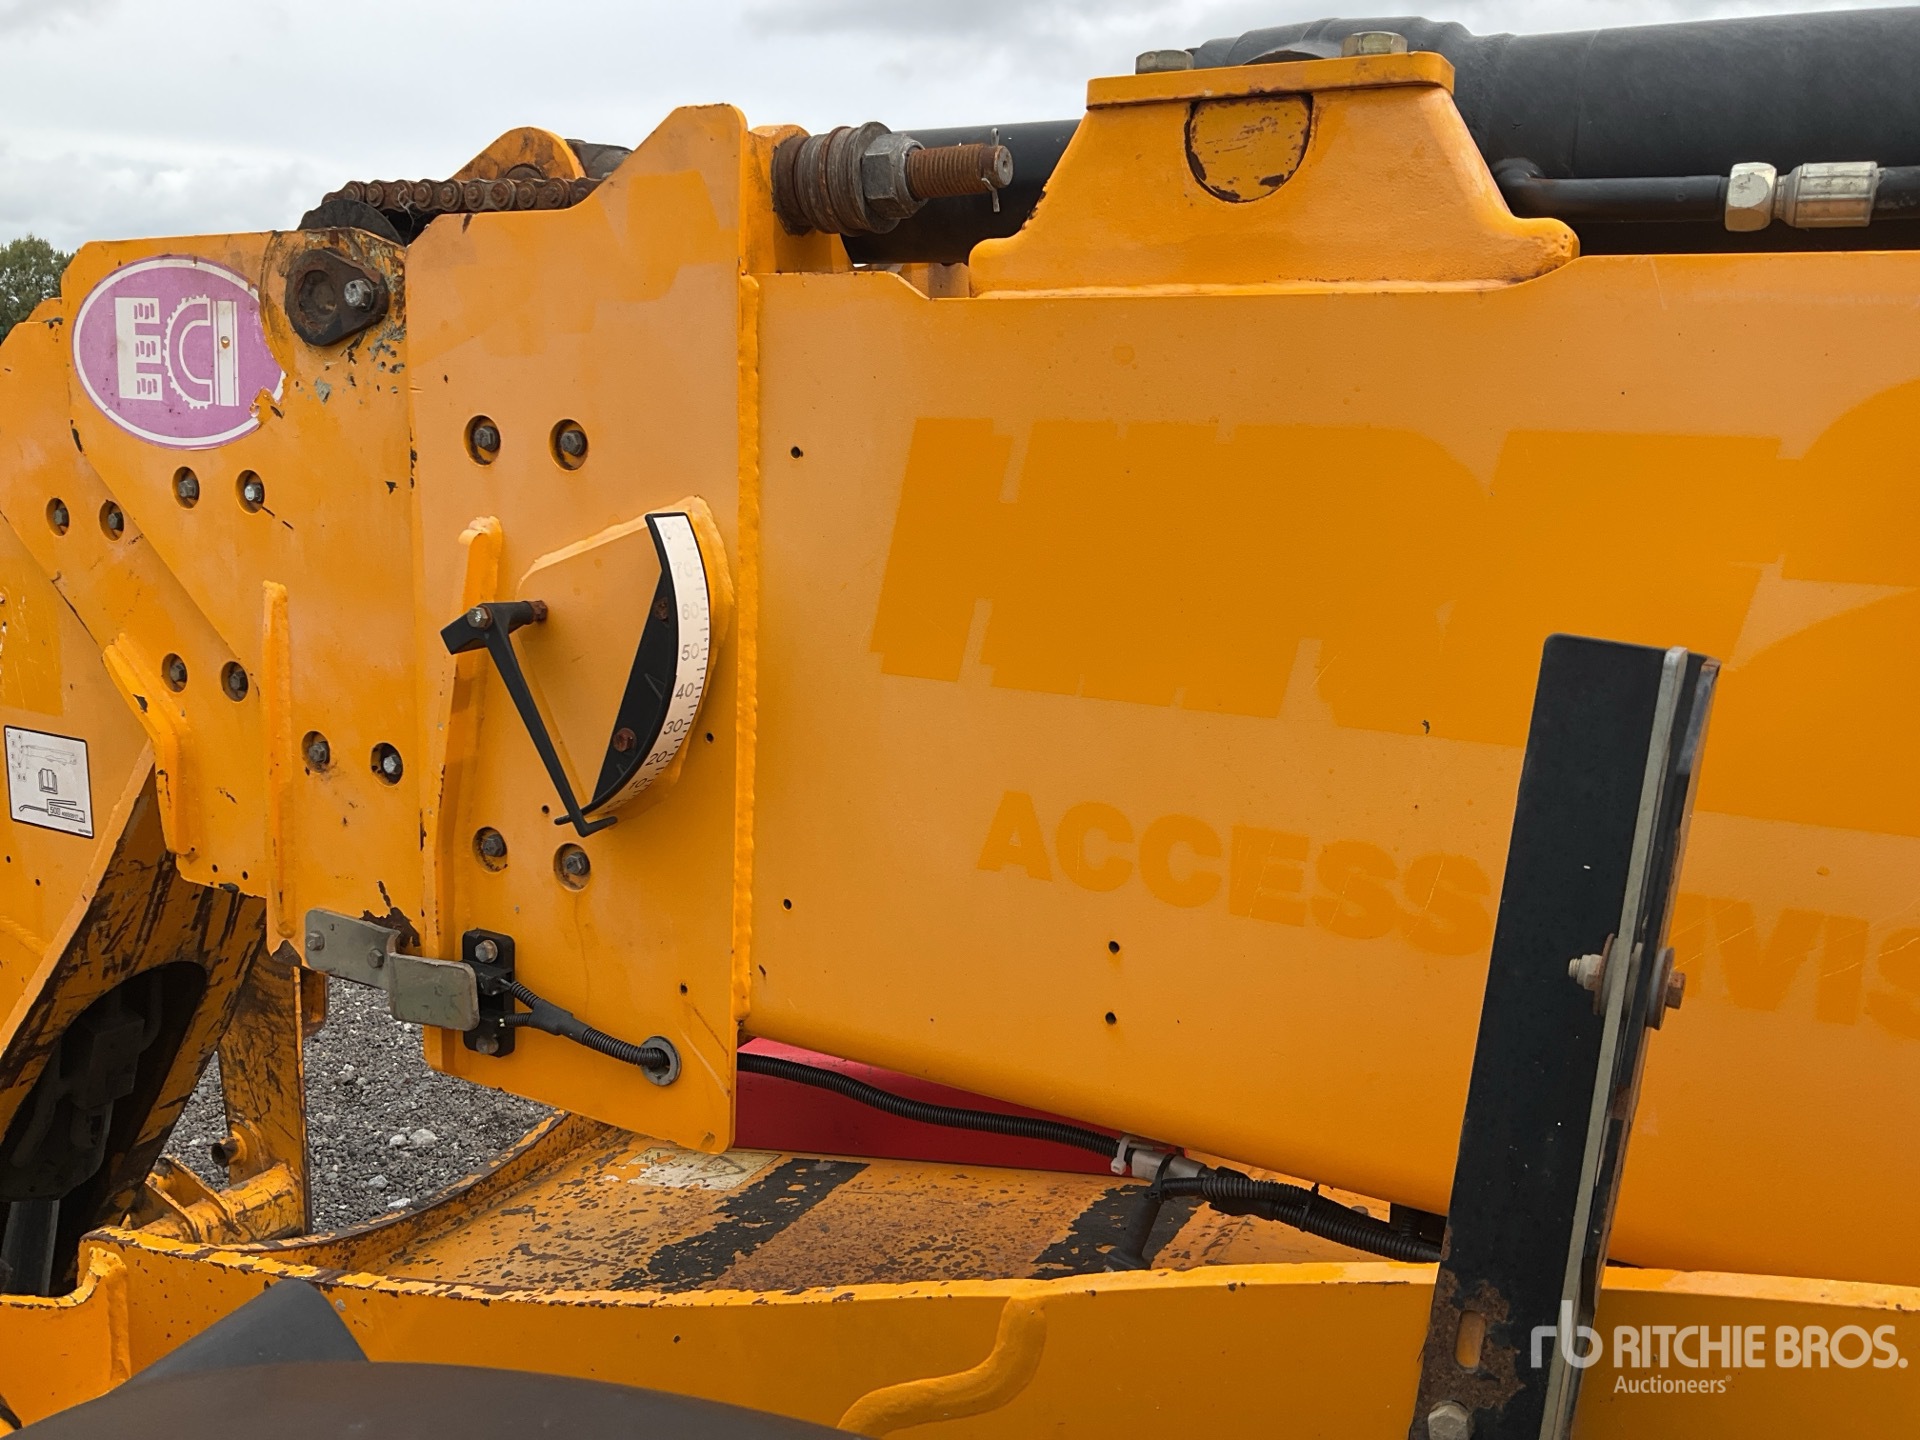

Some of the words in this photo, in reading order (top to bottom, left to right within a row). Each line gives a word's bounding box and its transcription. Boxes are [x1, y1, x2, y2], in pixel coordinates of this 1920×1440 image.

[673, 561, 693, 579] 70
[681, 602, 700, 620] 60
[681, 643, 700, 661] 50
[675, 682, 695, 699] 40
[663, 719, 684, 735] 30
[645, 750, 667, 767] 20
[628, 777, 647, 790] 10
[977, 790, 1493, 956] ACCESS
